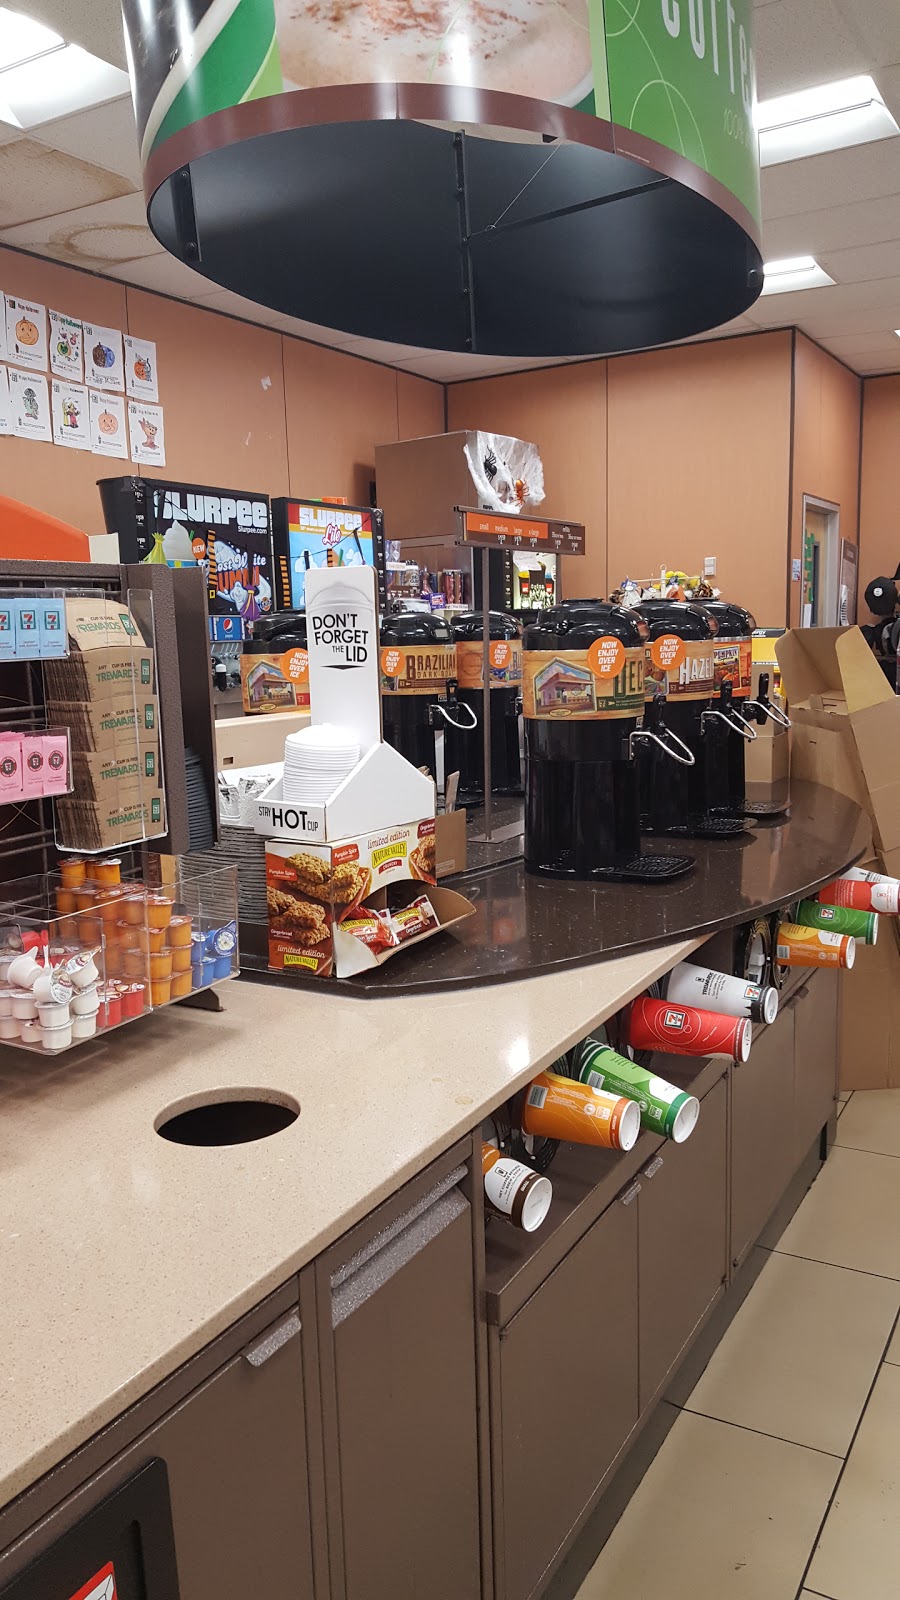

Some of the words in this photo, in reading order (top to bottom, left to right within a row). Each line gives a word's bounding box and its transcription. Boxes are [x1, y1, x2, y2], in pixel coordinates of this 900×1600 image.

[299, 507, 362, 532] SLURPEE
[238, 526, 267, 534] Slurpee.com
[322, 523, 342, 546] Lite
[192, 545, 205, 553] NEW
[312, 613, 358, 630] DON'T
[314, 629, 369, 646] FORGET
[602, 641, 617, 649] NOW
[294, 652, 308, 660] NOW
[346, 645, 368, 662] LID
[598, 649, 619, 657] ENJOY
[289, 658, 308, 666] ENJOY
[598, 657, 616, 665] OVER
[289, 664, 305, 673] OVER
[601, 665, 611, 673] ICE
[258, 806, 271, 817] STAY
[272, 807, 308, 830] HOT
[307, 820, 319, 832] CUP
[367, 837, 389, 850] limited
[389, 829, 410, 843] edition
[334, 849, 348, 858] Pumpkin
[348, 847, 357, 855] Spice
[373, 848, 391, 866] NATURE
[390, 843, 406, 857] VALLEY
[269, 868, 285, 876] Pumpkin
[270, 928, 293, 937] Gingerbread
[277, 944, 301, 955] limited
[301, 948, 325, 959] edition
[285, 955, 302, 964] NATURE
[302, 958, 318, 969] VALLEY
